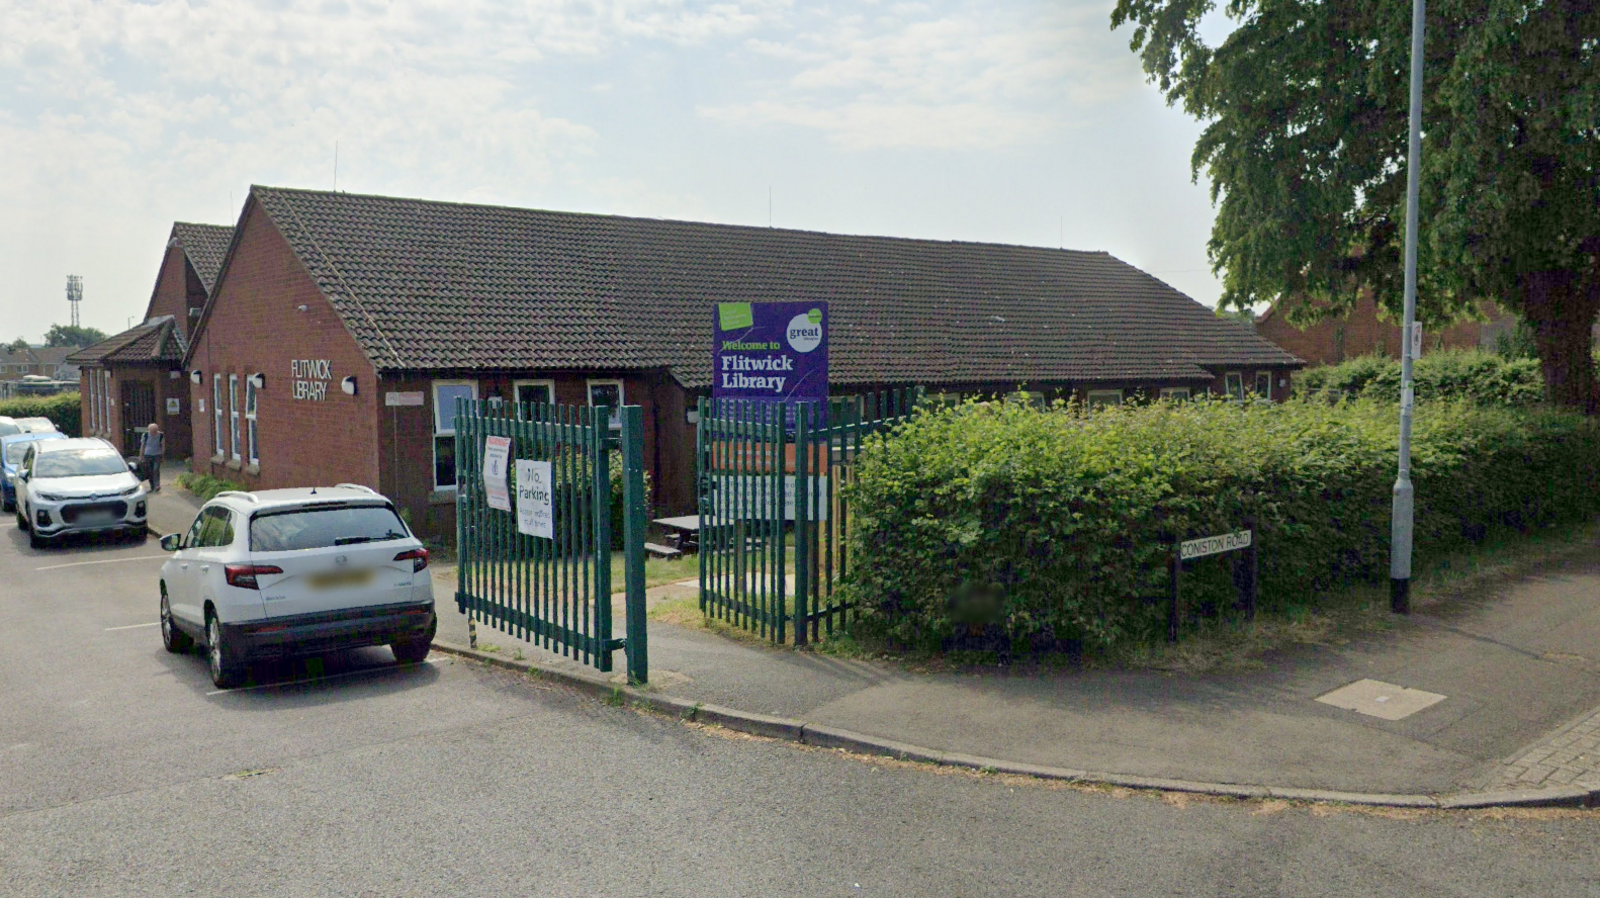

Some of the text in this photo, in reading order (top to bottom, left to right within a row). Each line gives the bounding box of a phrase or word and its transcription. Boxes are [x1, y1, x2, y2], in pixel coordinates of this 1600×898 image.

[790, 327, 819, 339] great
[722, 341, 780, 350] Welcome to
[291, 360, 332, 379] FLITWICK
[721, 355, 793, 370] Flitwick
[292, 380, 328, 400] LIBRARY
[721, 373, 786, 393] Library
[527, 468, 541, 483] No
[519, 485, 550, 505] Parking
[1181, 532, 1249, 557] CONISTON ROAD
